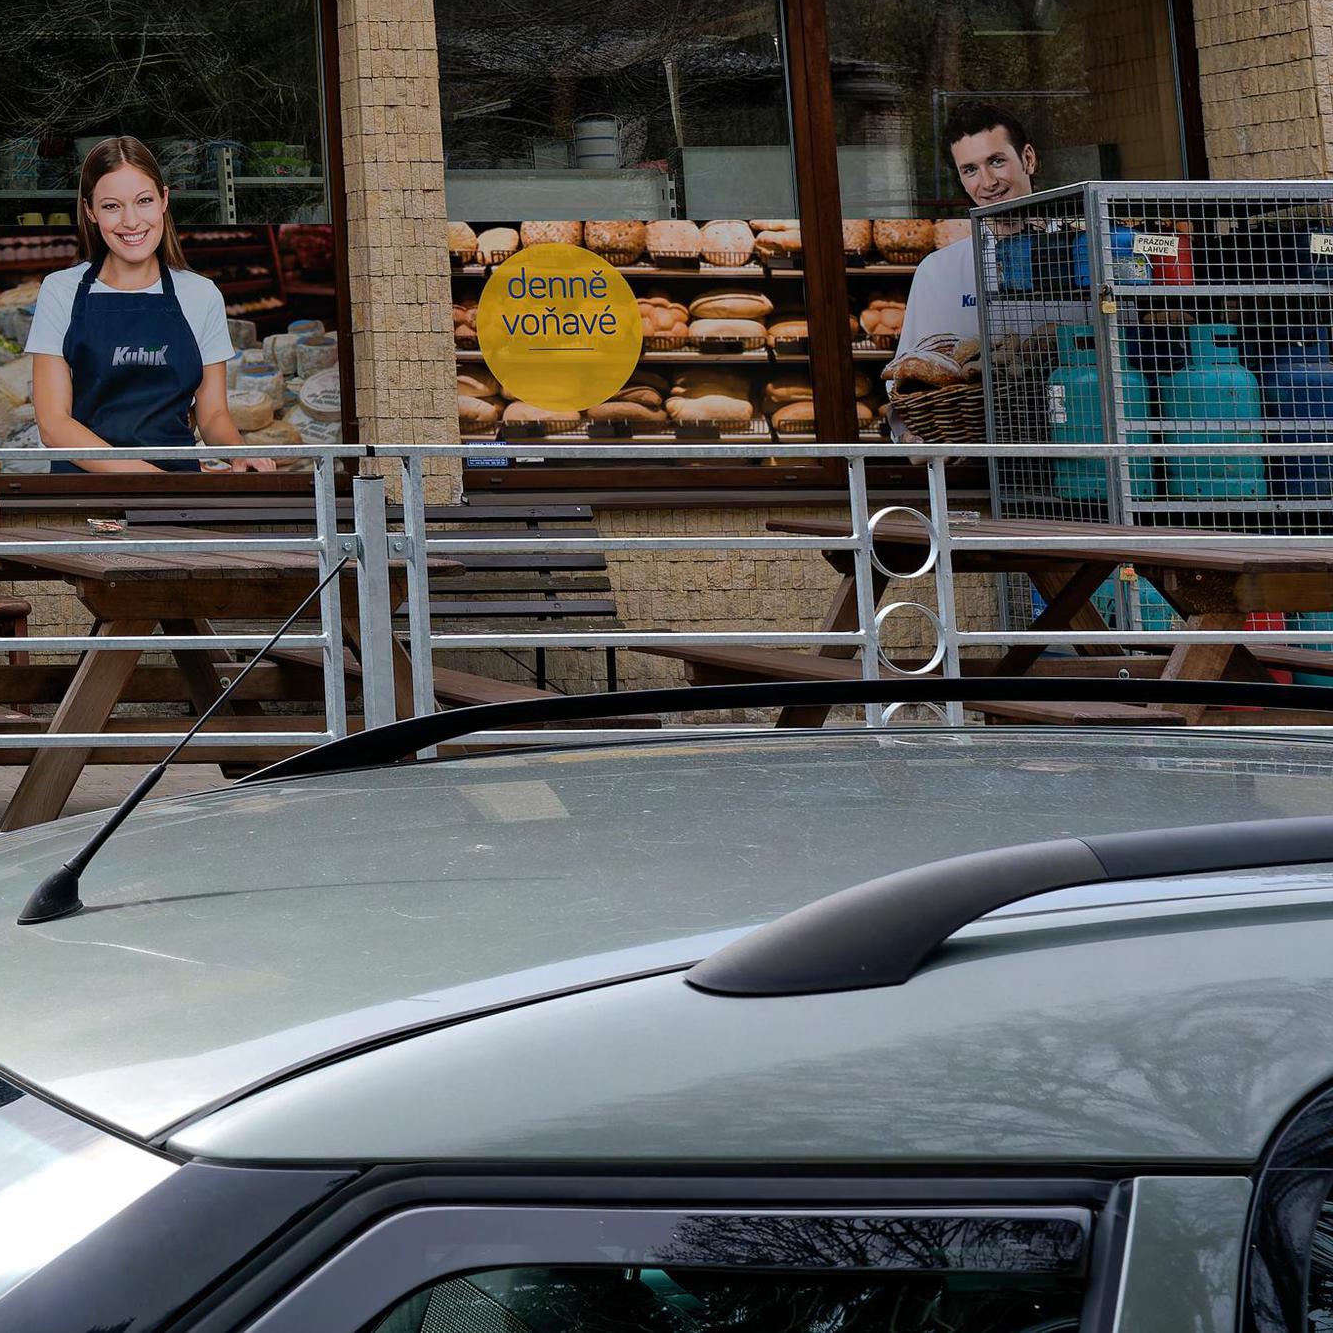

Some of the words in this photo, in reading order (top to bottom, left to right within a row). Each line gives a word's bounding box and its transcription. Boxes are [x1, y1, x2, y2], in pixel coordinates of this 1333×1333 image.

[1143, 246, 1169, 254] LAHVE
[508, 267, 607, 299] denně
[502, 305, 617, 335] voňavé
